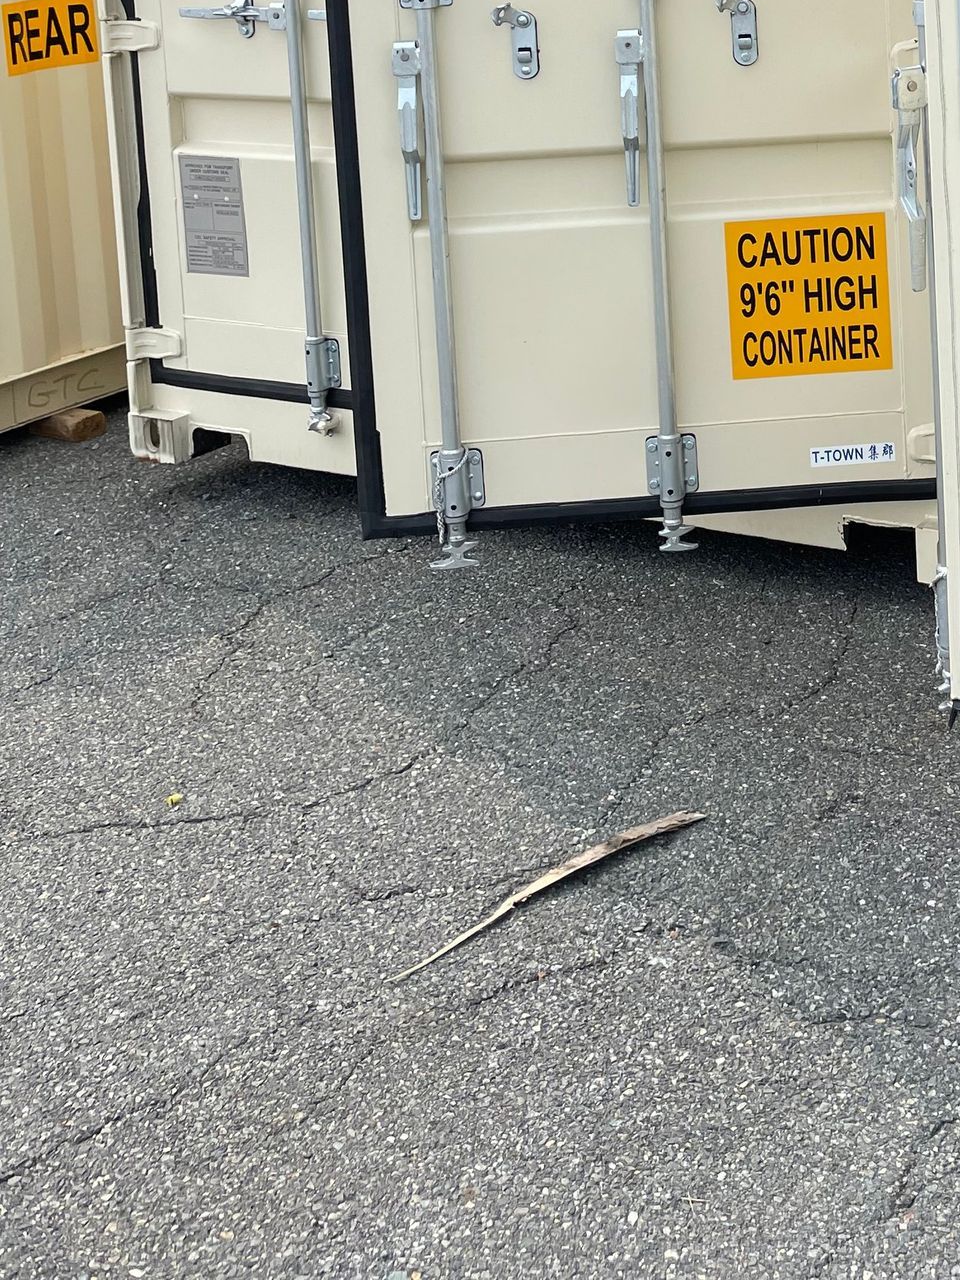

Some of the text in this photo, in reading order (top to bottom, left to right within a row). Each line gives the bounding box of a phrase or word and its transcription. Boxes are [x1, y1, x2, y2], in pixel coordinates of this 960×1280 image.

[8, 4, 94, 65] REAR
[738, 226, 875, 269] CAUTION
[804, 275, 878, 312] HIGH
[743, 325, 880, 368] CONTAINER
[812, 447, 864, 463] T-TOWN
